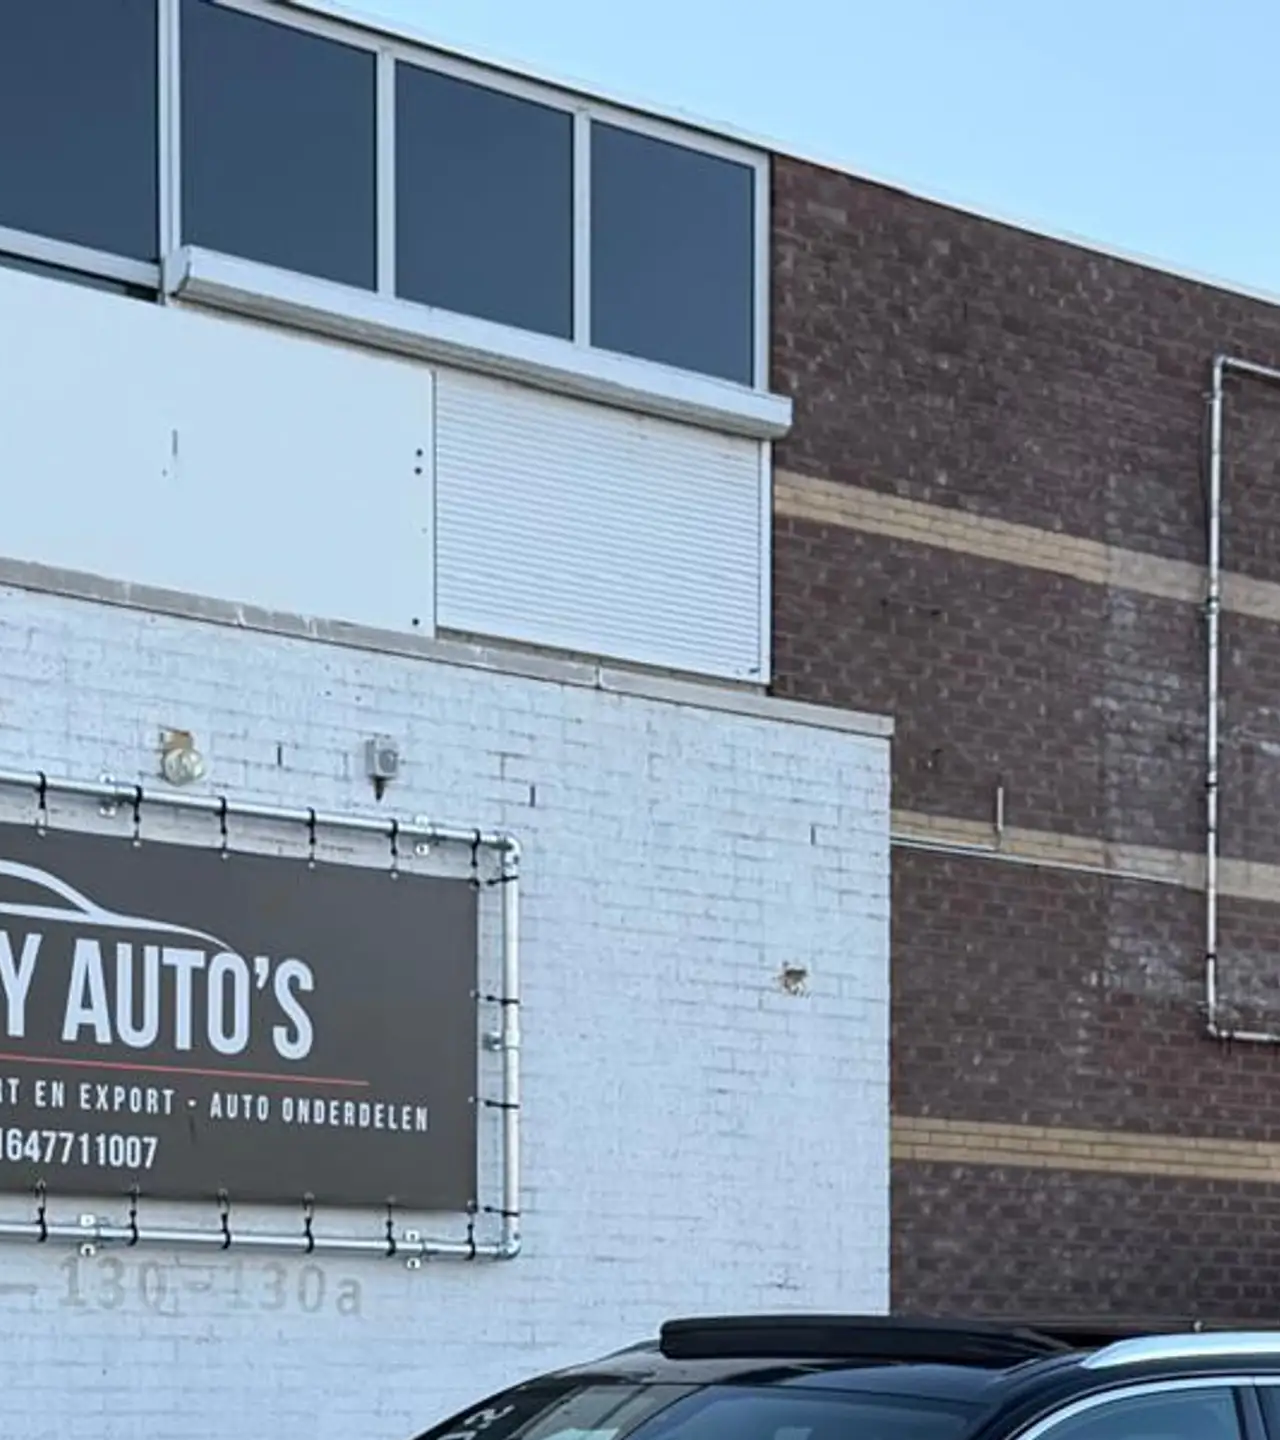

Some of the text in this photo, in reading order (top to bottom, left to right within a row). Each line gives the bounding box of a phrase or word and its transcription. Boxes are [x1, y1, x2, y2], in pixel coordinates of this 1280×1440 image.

[62, 937, 314, 1060] AUTO'S
[34, 1079, 65, 1109] EN
[79, 1082, 176, 1116] EXPORT
[209, 1091, 269, 1123] AUTO
[282, 1096, 429, 1133] ONDERDELEN
